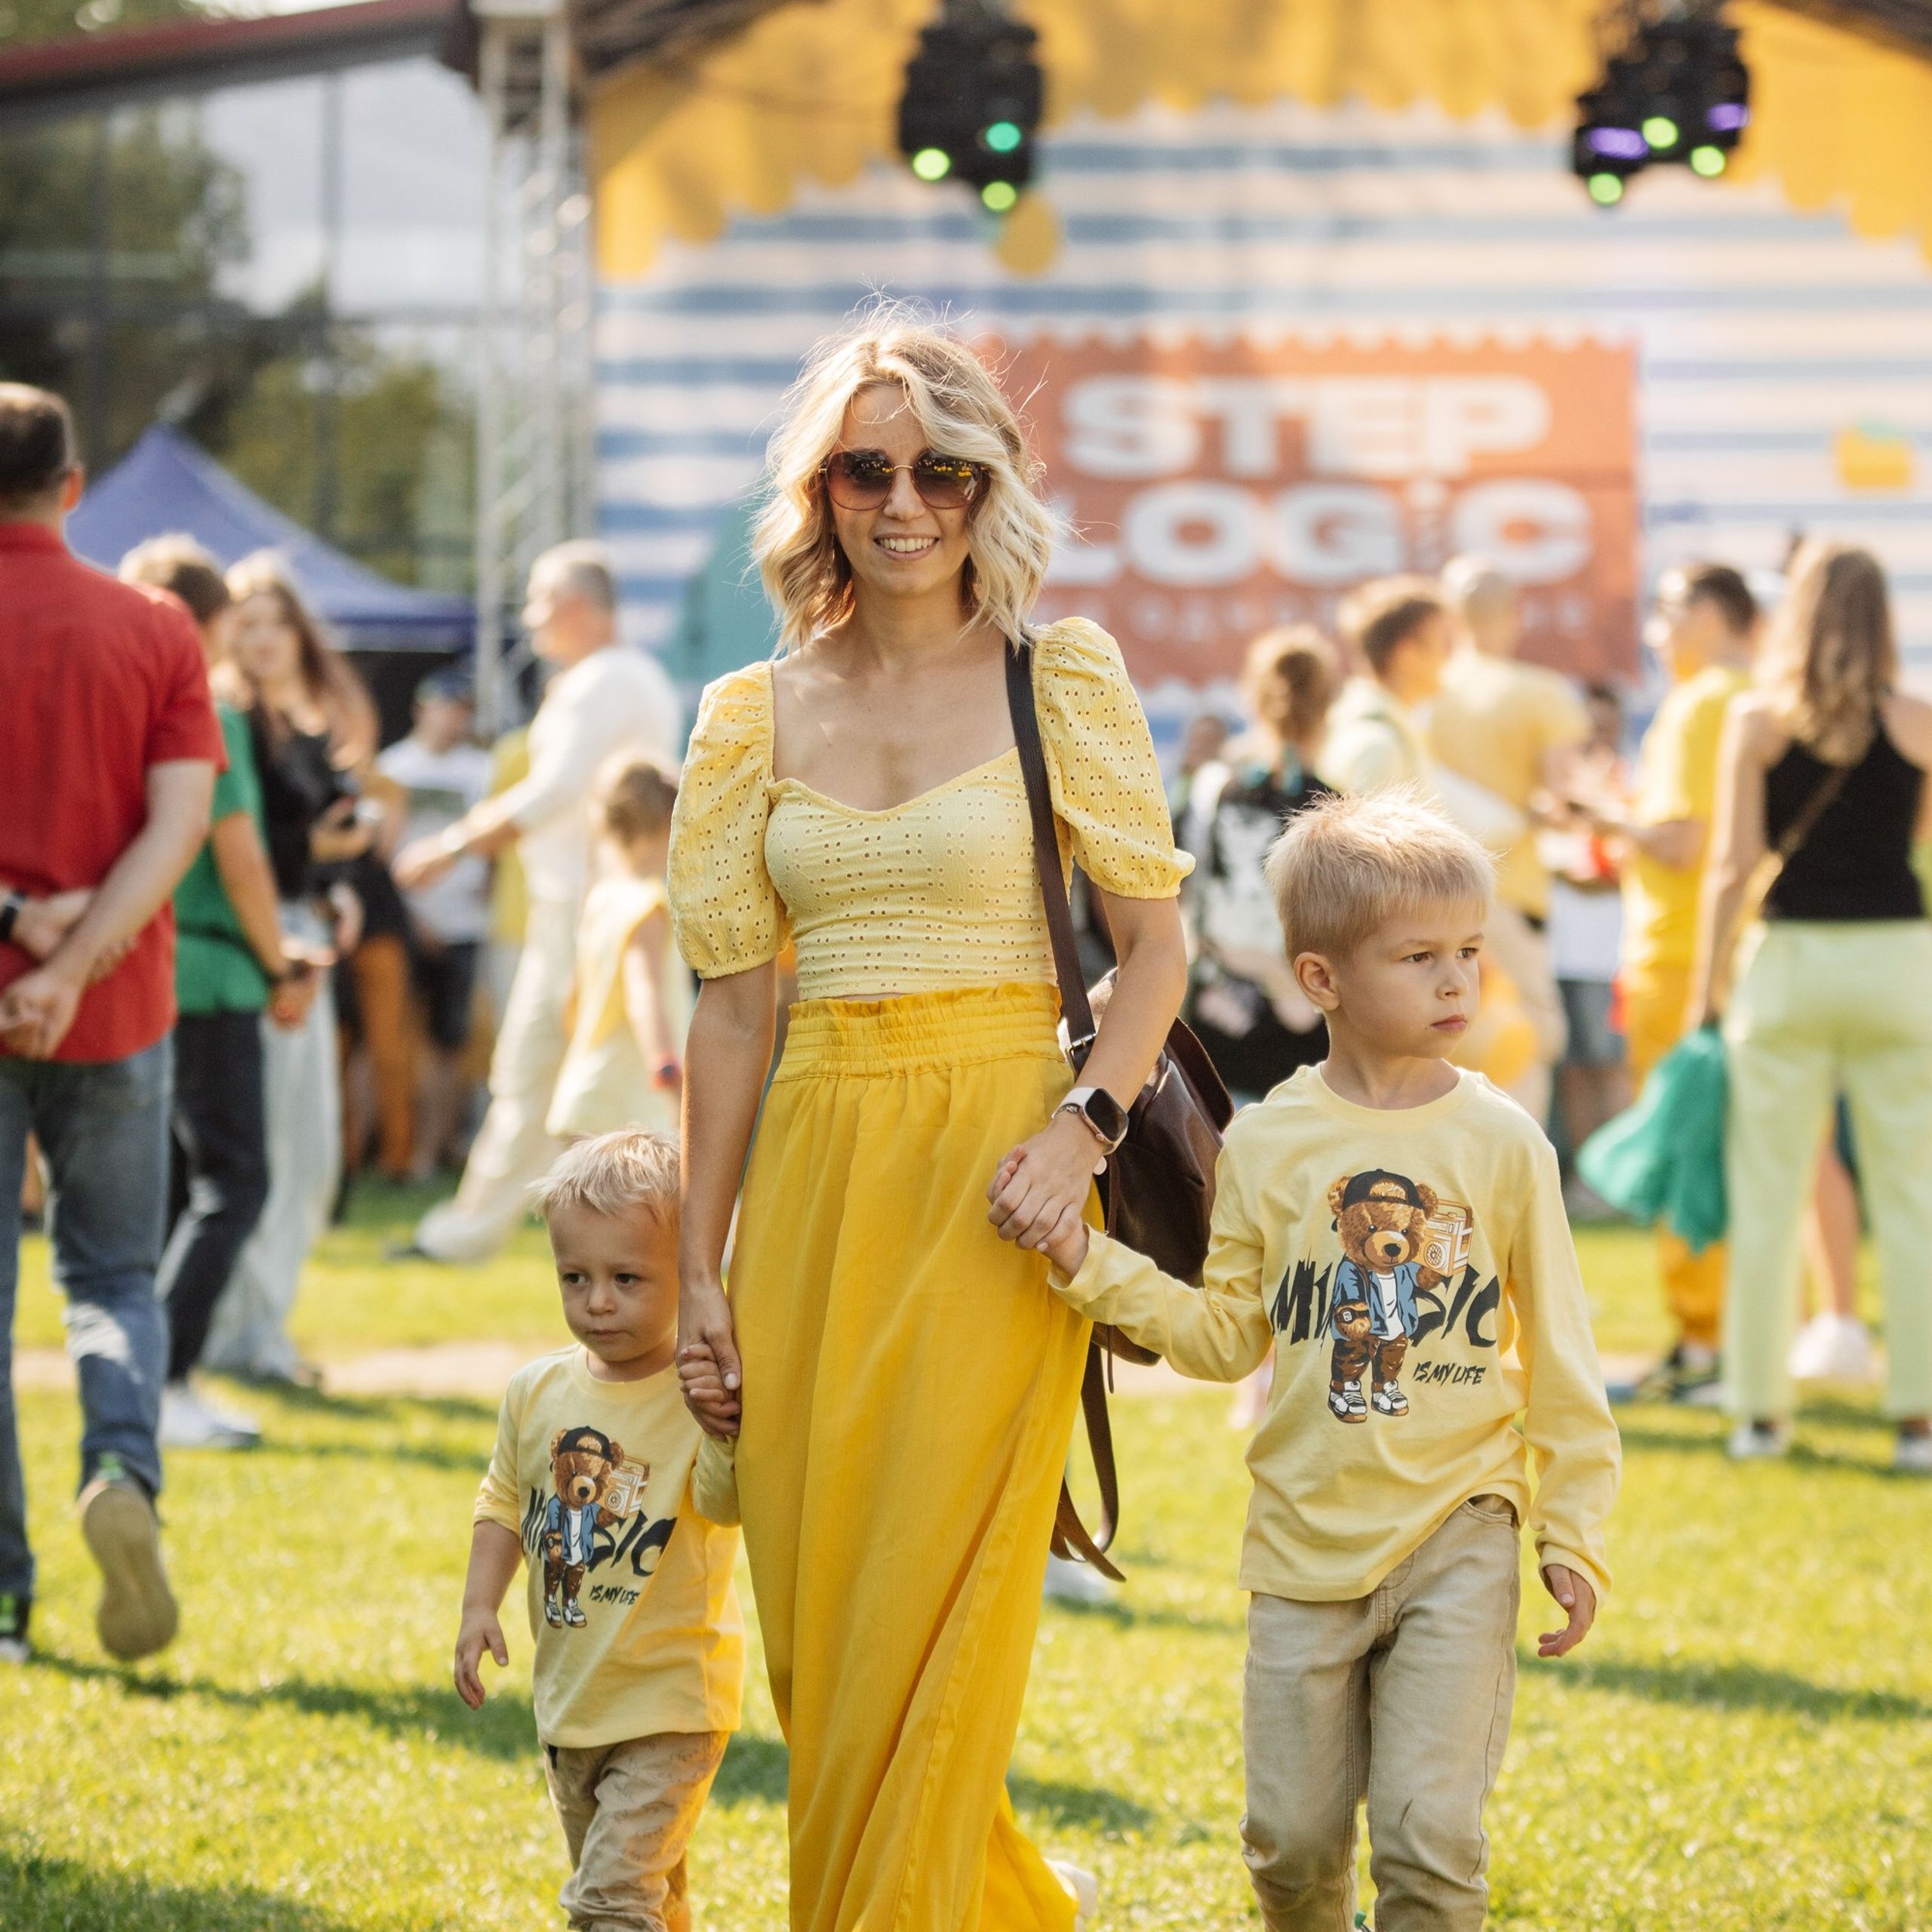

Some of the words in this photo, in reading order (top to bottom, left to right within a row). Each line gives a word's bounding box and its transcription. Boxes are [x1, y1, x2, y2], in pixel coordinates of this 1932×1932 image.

[1063, 372, 1550, 480] STEP
[1412, 1361, 1432, 1382] IS
[1425, 1362, 1457, 1386] MY
[1451, 1365, 1487, 1386] LIFE
[521, 1485, 678, 1577] MSIC
[589, 1585, 604, 1601] IS
[599, 1586, 623, 1605] MY
